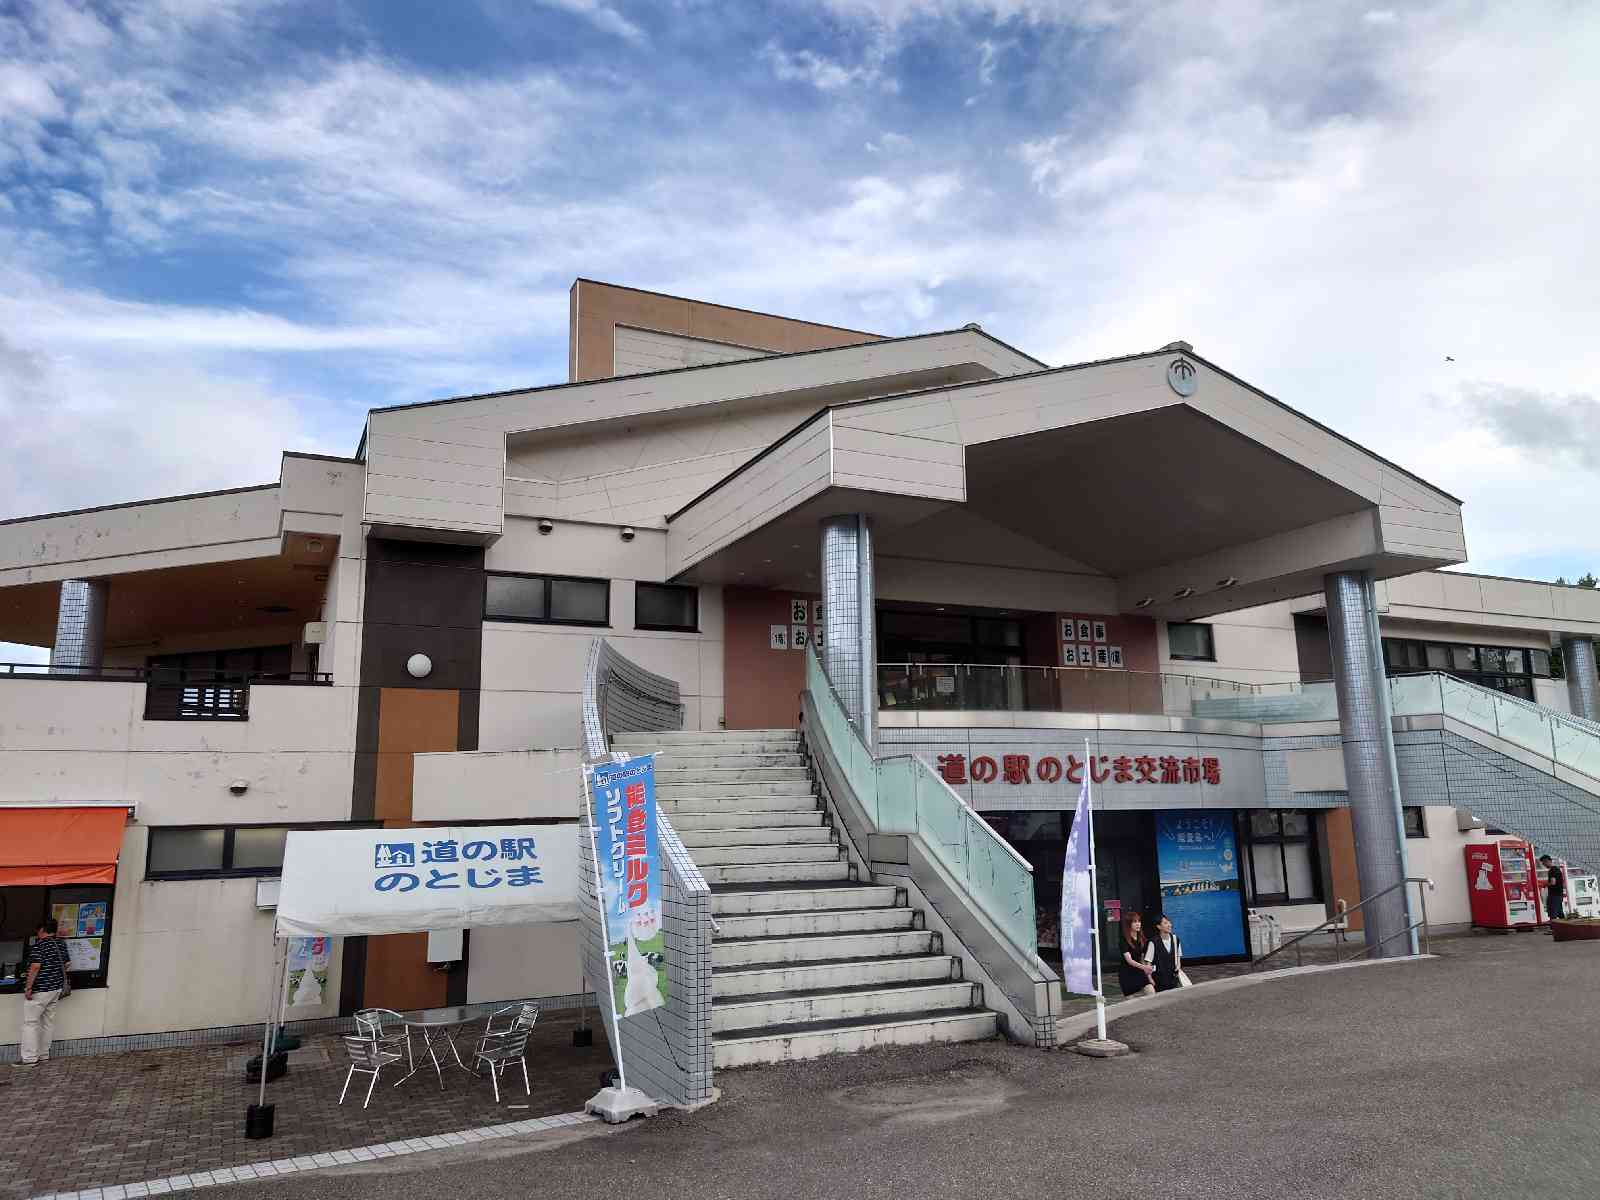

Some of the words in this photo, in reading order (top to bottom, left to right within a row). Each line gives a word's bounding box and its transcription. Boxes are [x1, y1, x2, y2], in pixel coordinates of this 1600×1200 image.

[937, 753, 1221, 785] 道の駅のとじま交流市場
[421, 837, 538, 864] 道の駅
[606, 787, 626, 915] ソフトクリーム
[374, 865, 544, 892] のとじま
